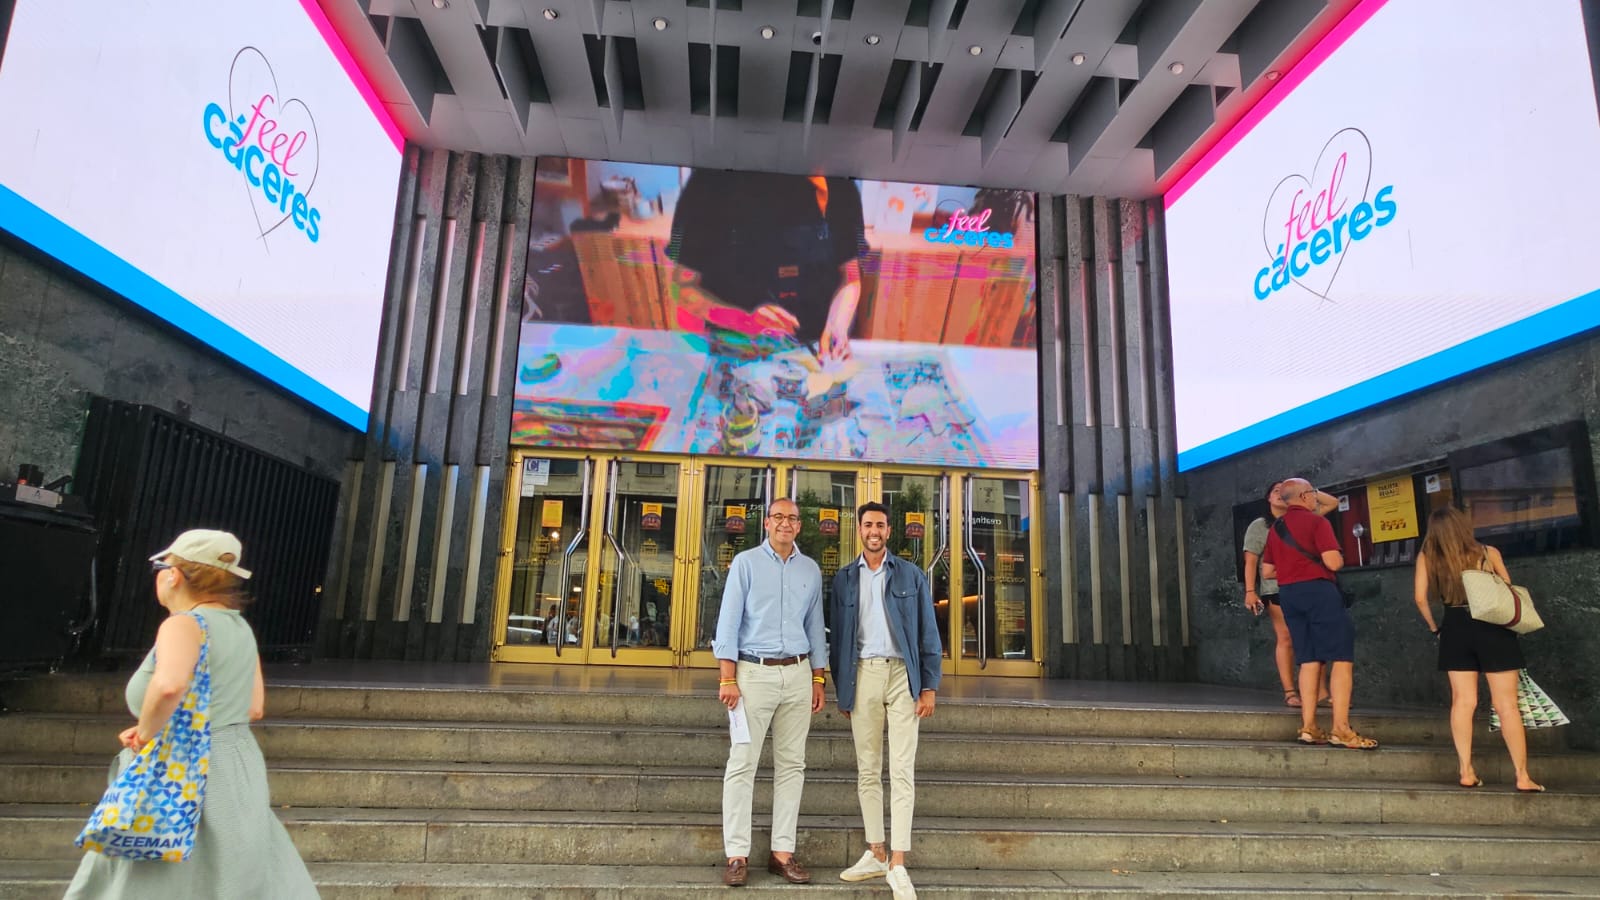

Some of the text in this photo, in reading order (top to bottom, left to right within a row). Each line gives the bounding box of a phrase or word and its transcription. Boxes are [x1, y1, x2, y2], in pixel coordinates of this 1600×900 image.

[203, 102, 321, 243] cáceres
[234, 94, 307, 177] feel
[942, 208, 992, 239] feel
[1253, 185, 1397, 300] cáceres
[1279, 151, 1348, 274] feel
[110, 833, 182, 848] ZEEMAN
